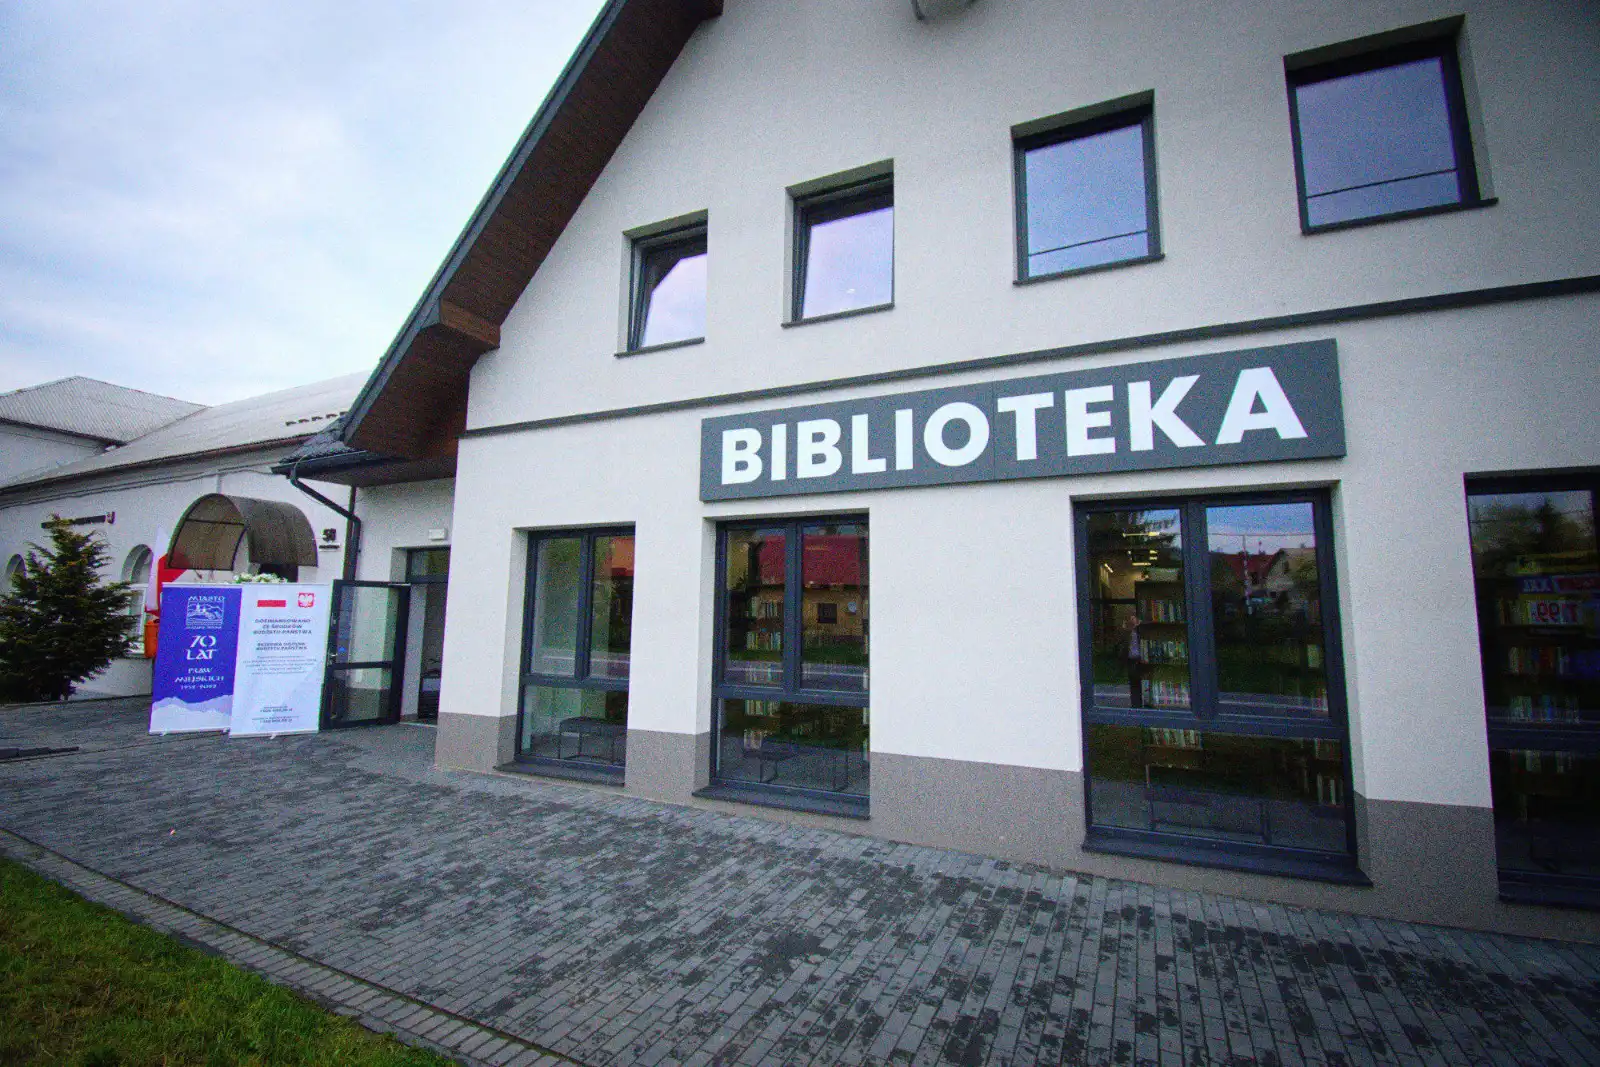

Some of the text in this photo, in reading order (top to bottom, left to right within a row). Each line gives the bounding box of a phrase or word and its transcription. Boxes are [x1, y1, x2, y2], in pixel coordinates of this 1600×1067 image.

[721, 366, 1308, 486] BIBLIOTEKA
[190, 635, 217, 648] 70
[185, 648, 219, 660] LAT
